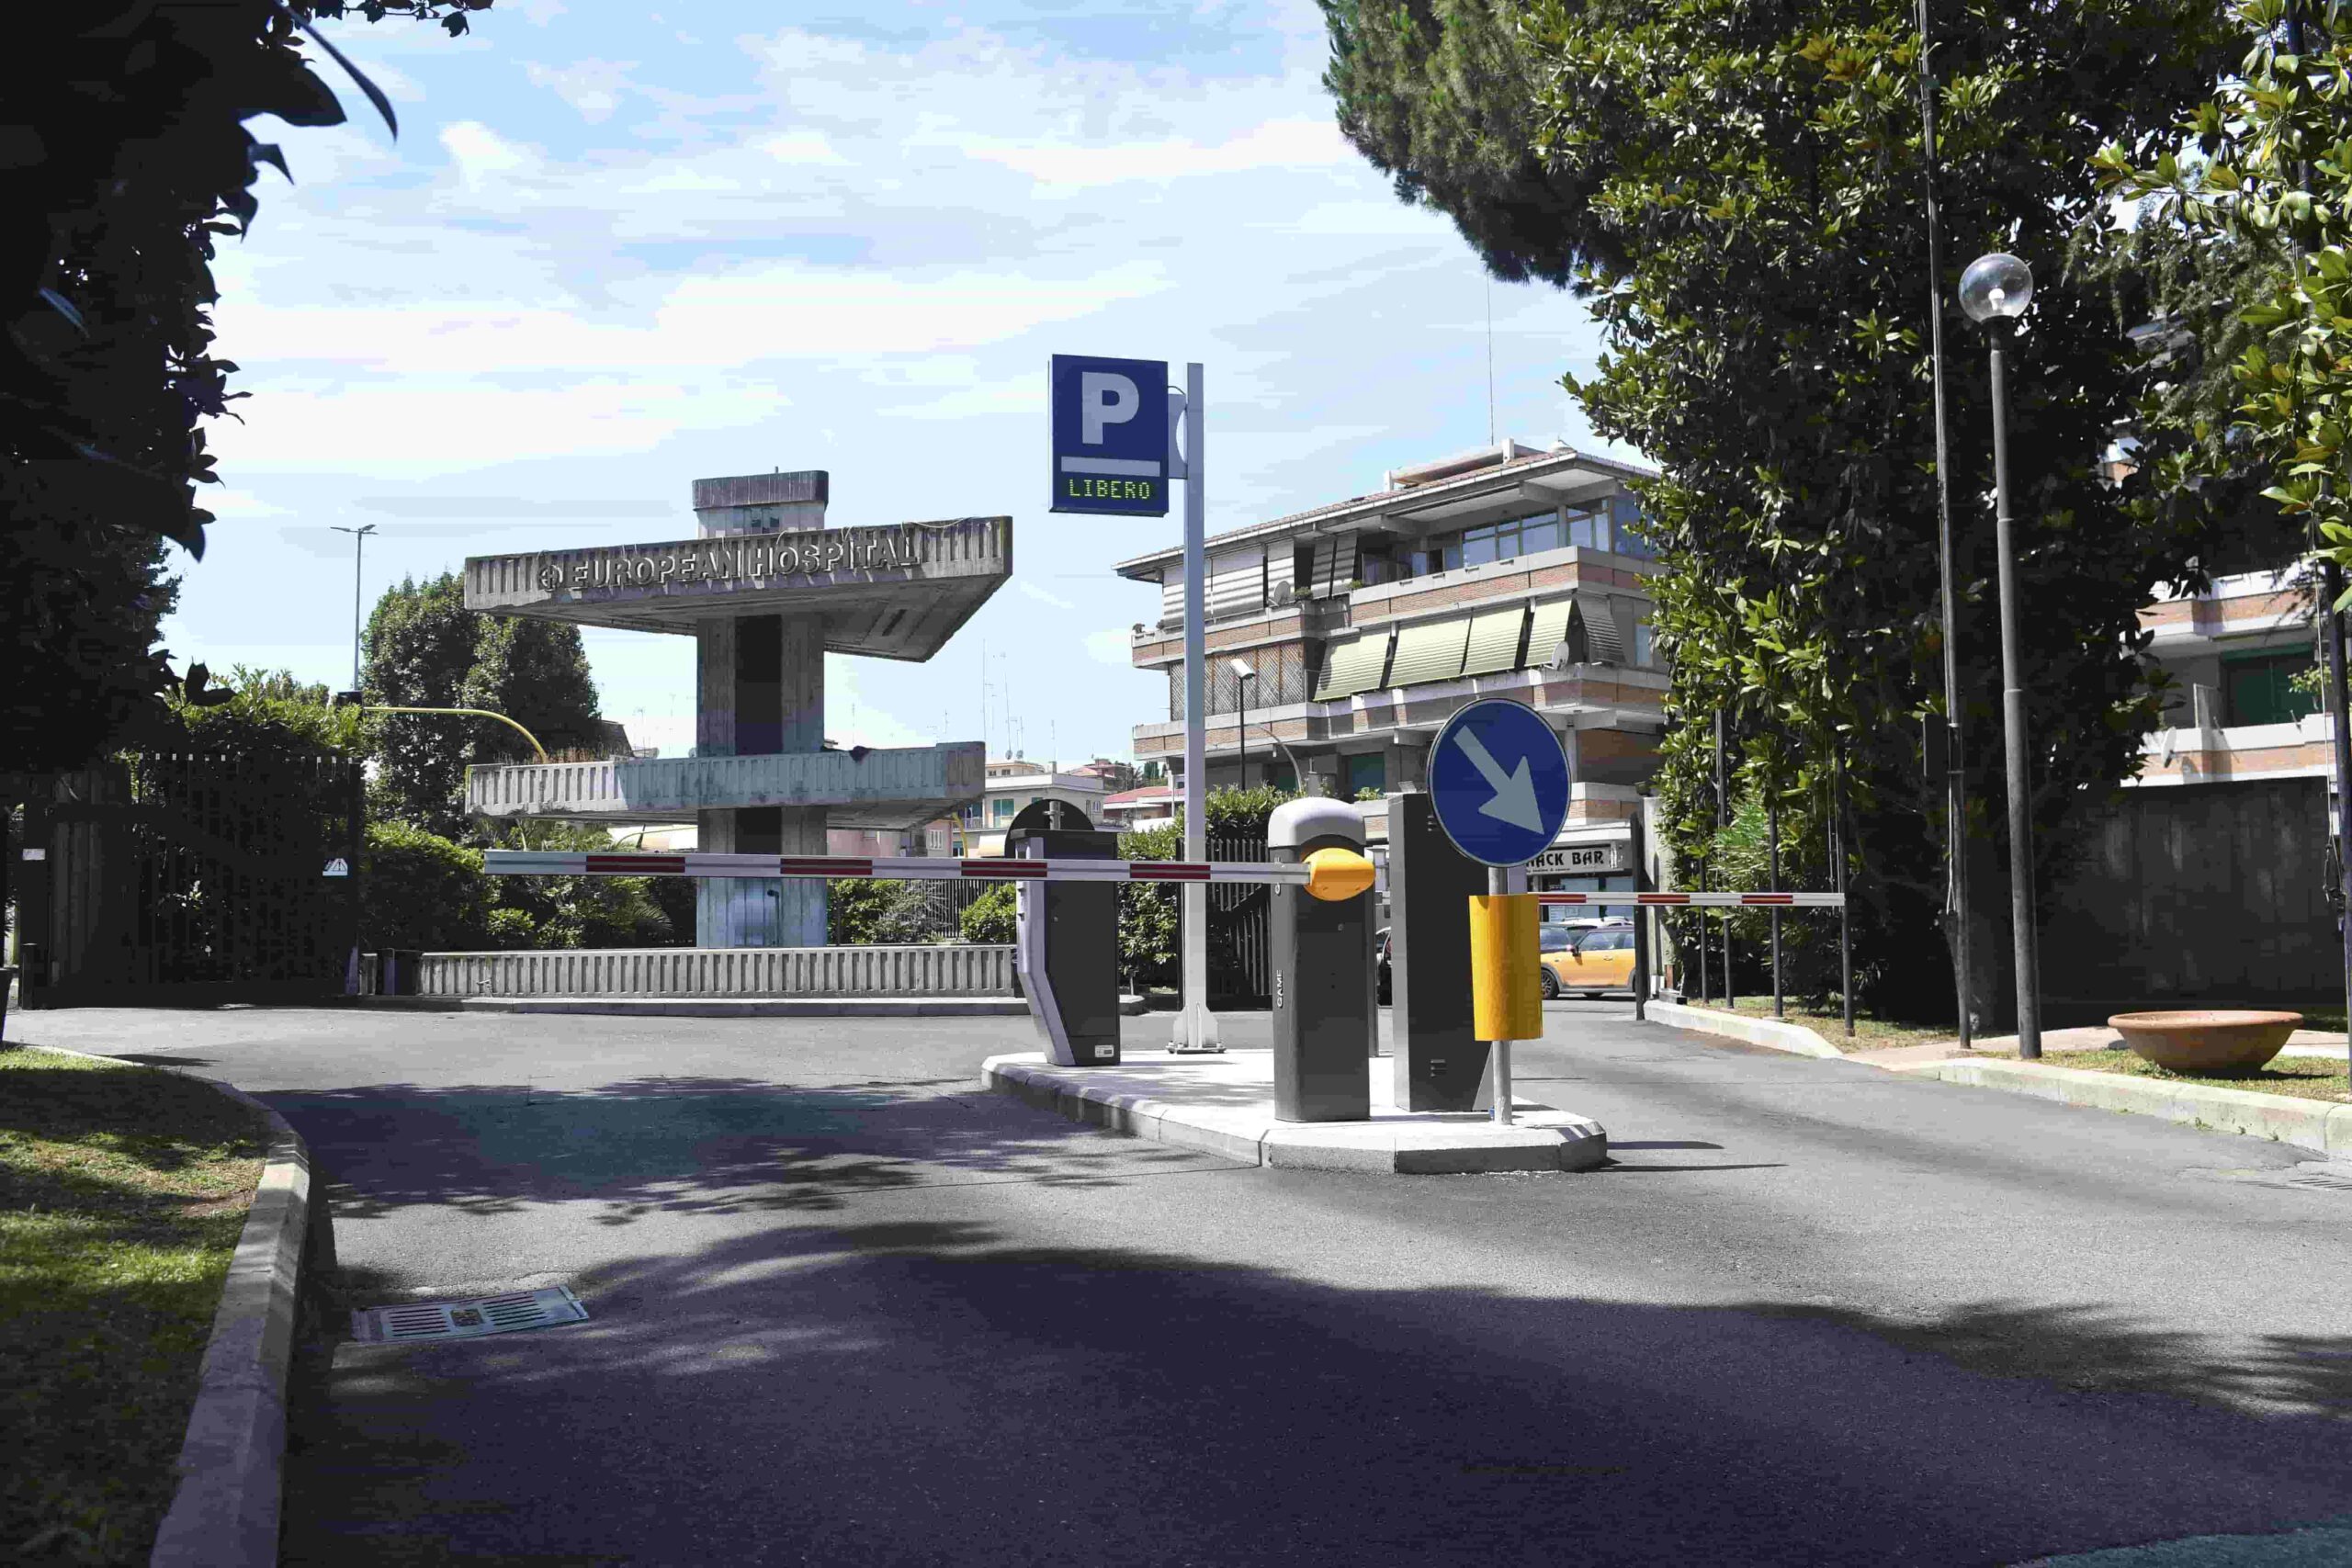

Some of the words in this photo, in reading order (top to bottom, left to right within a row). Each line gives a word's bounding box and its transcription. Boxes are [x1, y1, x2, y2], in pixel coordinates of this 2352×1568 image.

[1081, 371, 1139, 445] P
[1069, 479, 1150, 500] LIBERO
[563, 549, 741, 590] EUROPEAN
[747, 536, 922, 577] HOSPITAL
[1572, 851, 1604, 865] BAR
